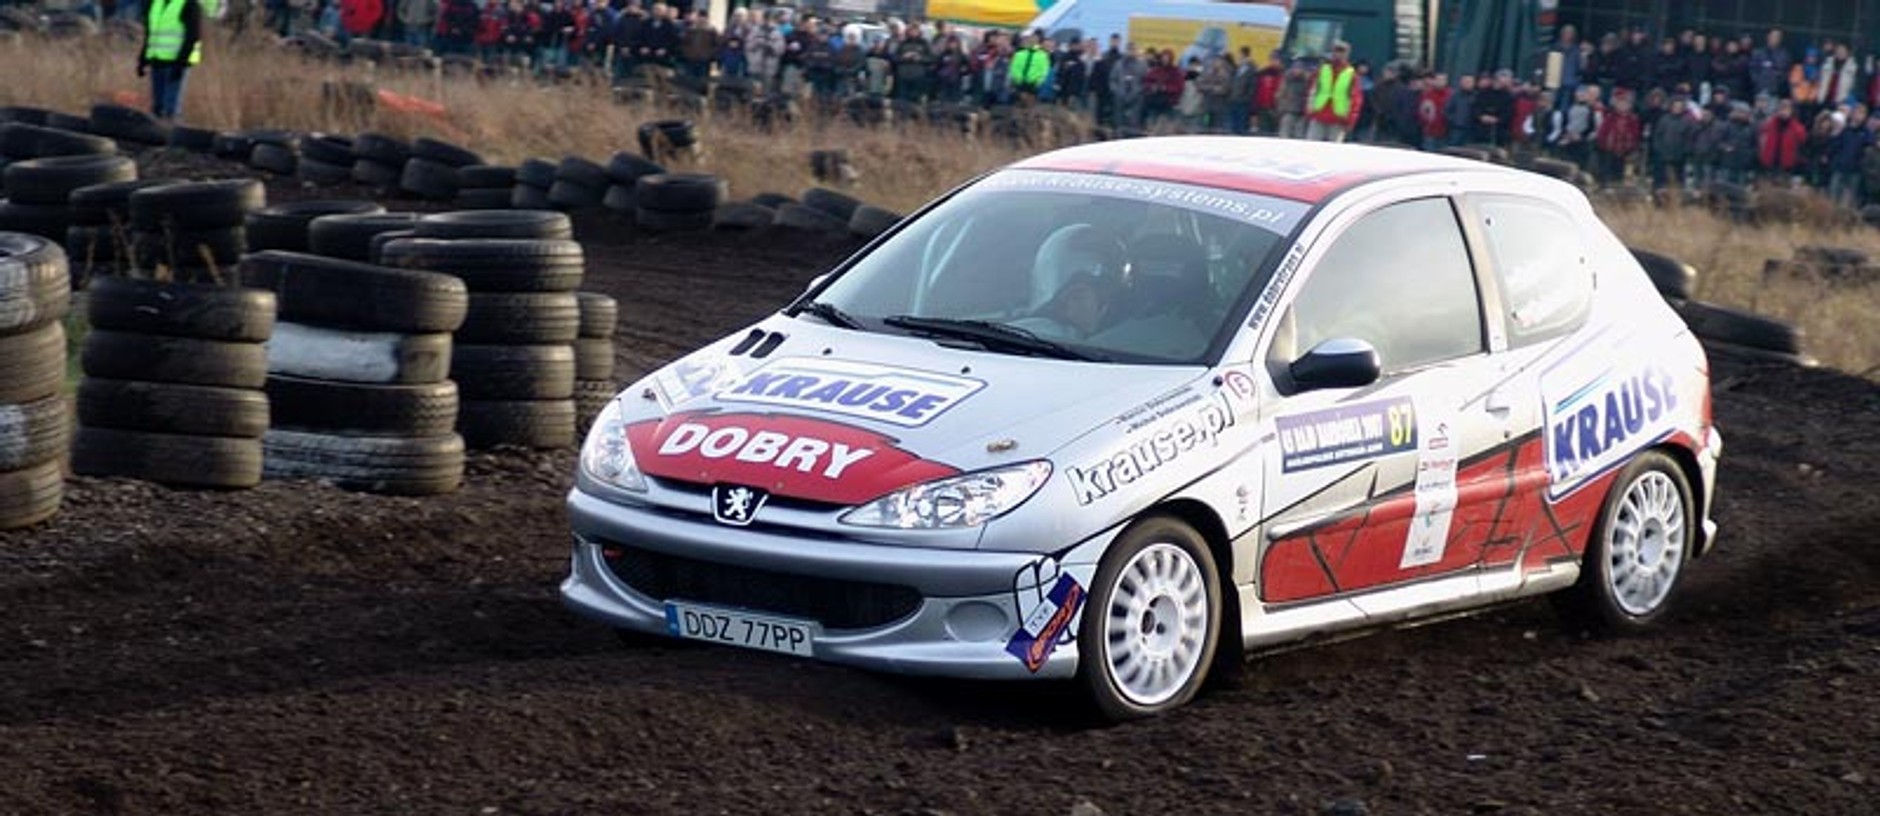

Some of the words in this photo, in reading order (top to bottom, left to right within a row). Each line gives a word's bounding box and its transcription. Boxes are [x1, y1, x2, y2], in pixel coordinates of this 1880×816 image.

[732, 373, 948, 420] KRAUSE
[1065, 389, 1236, 507] krause.pl
[1388, 404, 1413, 446] 87
[1554, 367, 1678, 480] KRAUSE
[659, 423, 874, 479] DOBRY
[684, 611, 735, 641] DDZ
[741, 620, 805, 651] 77PP
